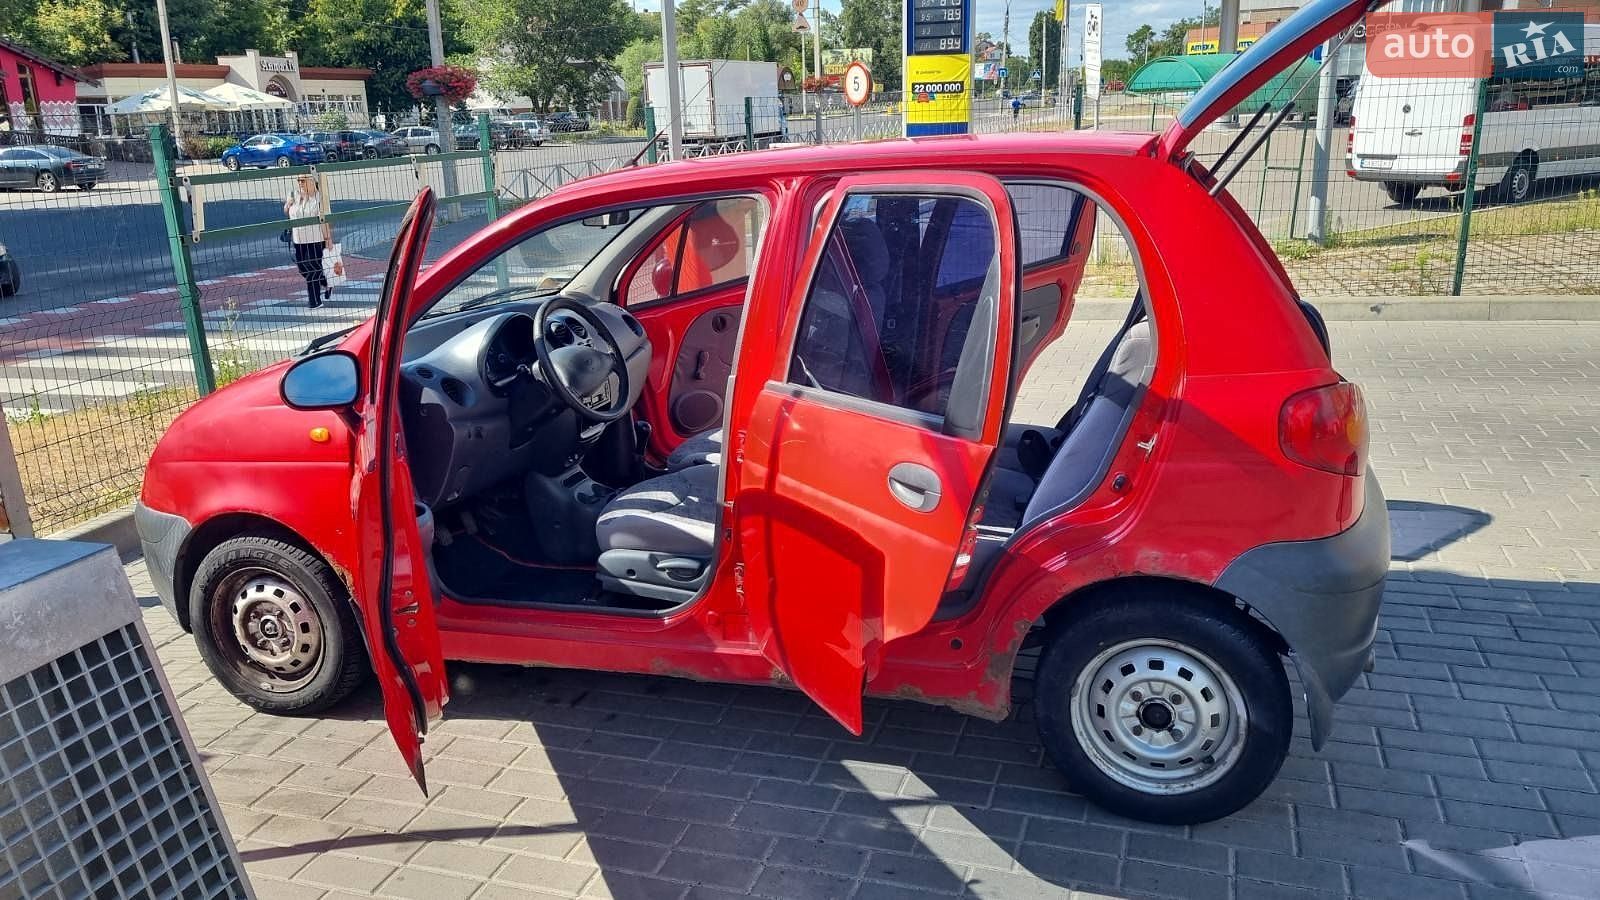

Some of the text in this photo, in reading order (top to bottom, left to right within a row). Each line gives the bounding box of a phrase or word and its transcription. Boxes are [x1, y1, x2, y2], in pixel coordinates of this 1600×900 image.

[854, 76, 860, 92] 5
[914, 82, 961, 92] 22 000 000
